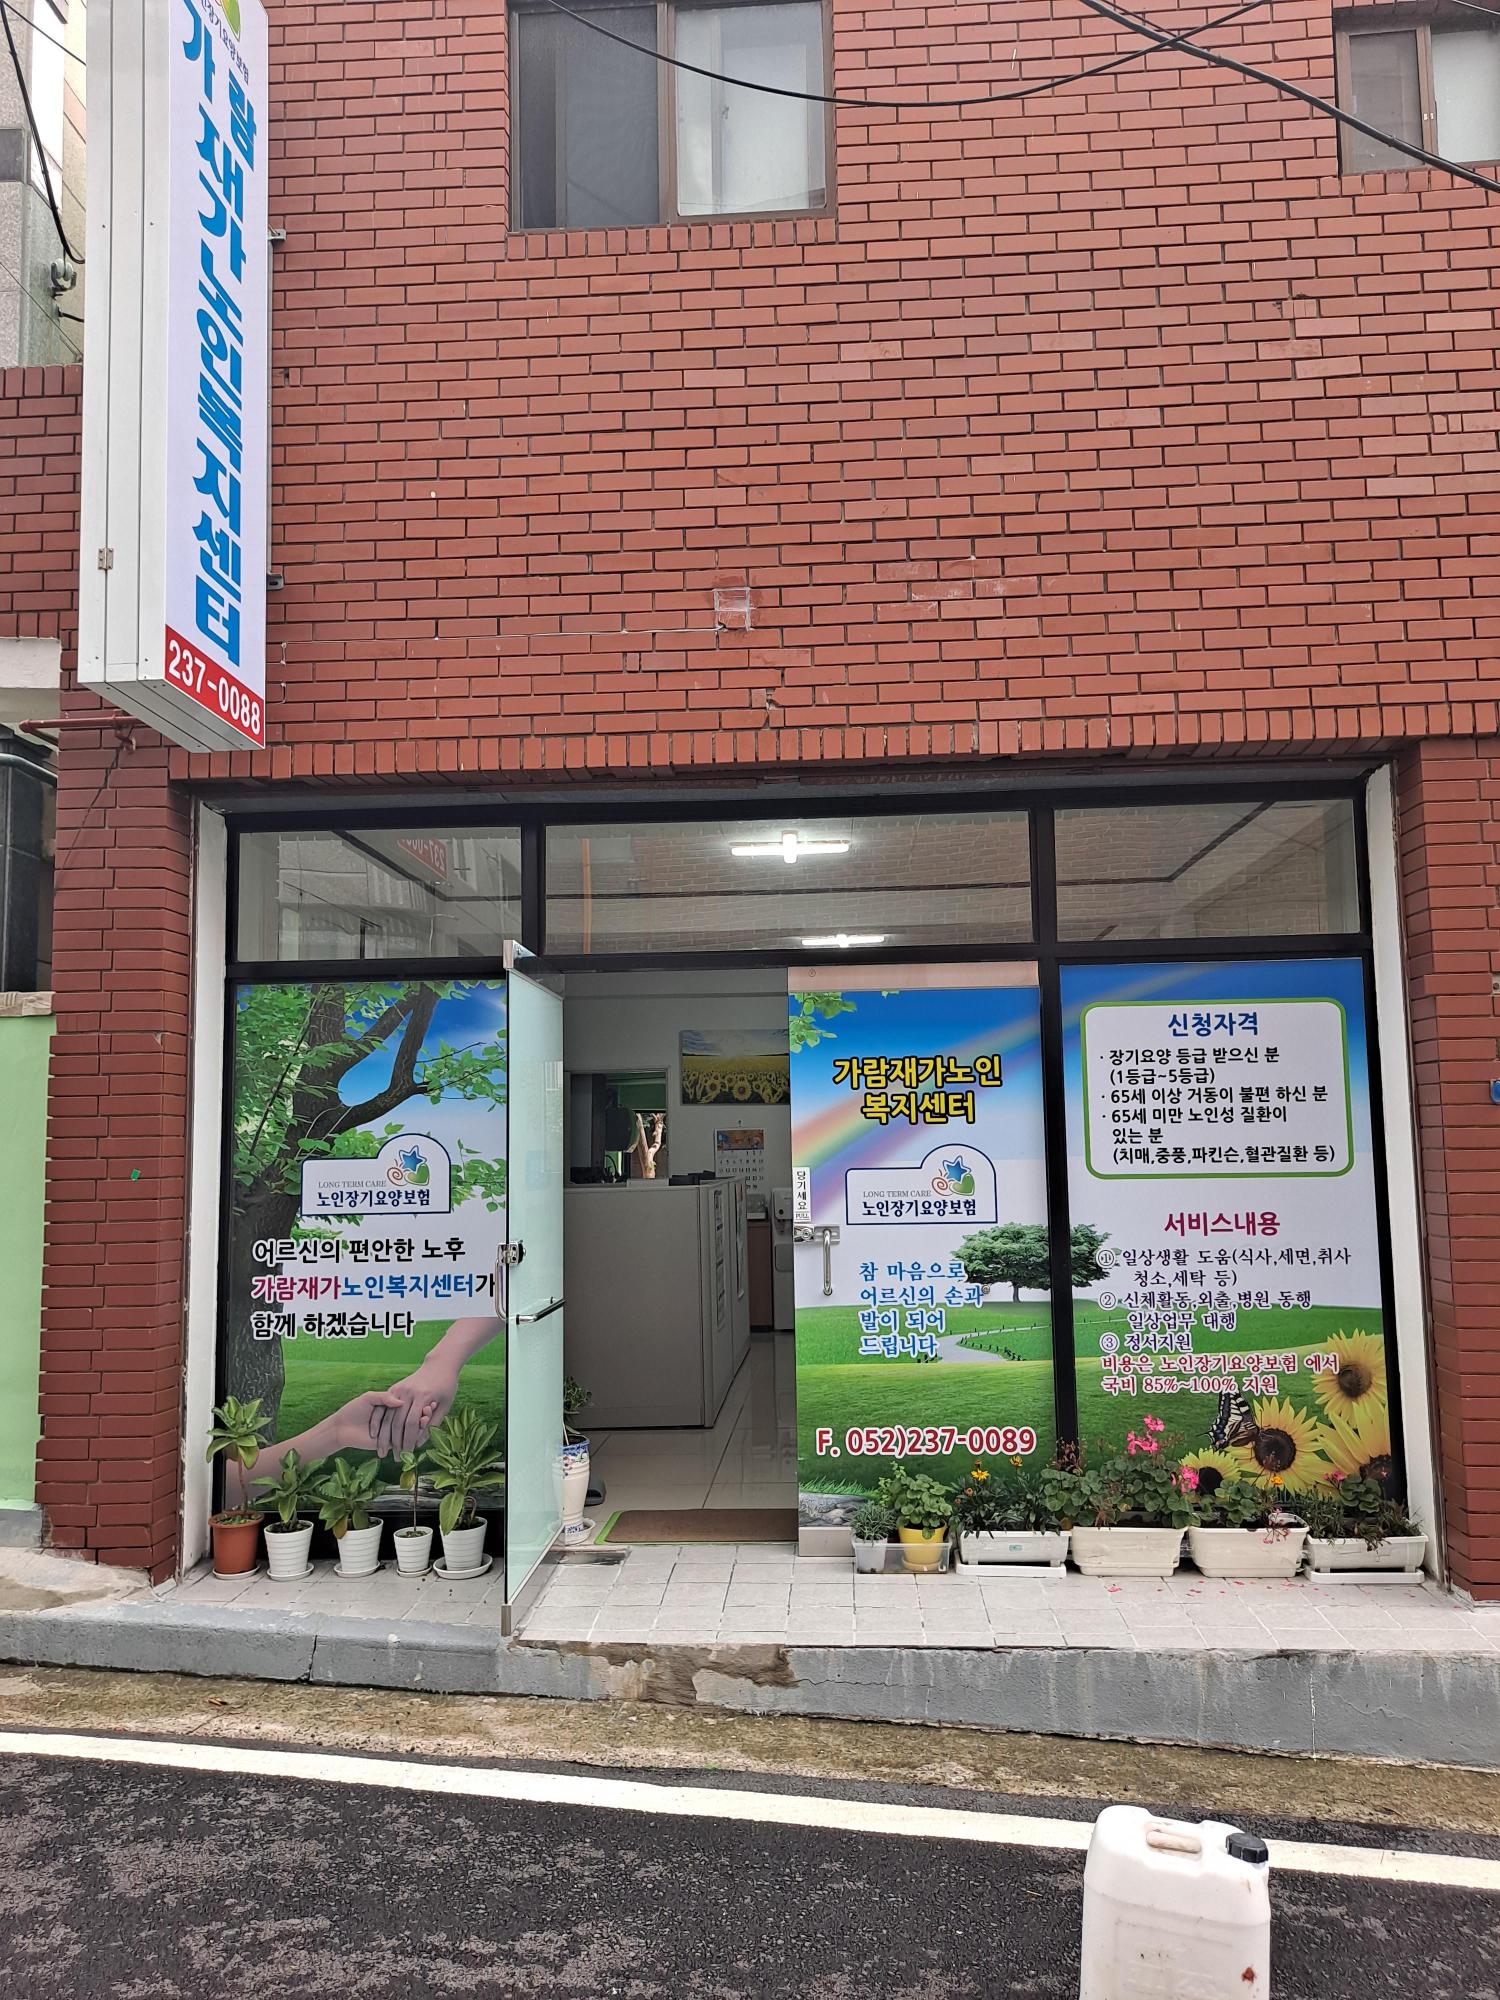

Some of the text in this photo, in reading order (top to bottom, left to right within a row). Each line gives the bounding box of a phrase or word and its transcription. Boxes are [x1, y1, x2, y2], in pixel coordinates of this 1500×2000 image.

[169, 639, 260, 735] 237-0088
[1168, 1012, 1259, 1038] 신청자격
[1109, 1046, 1280, 1066] 장기요양 등급 받으신 분
[833, 1054, 1002, 1089] 가람재가노인
[1110, 1067, 1215, 1086] (1등급~5등급)
[1110, 1086, 1328, 1105] 65세 이상 거동이 불편 하신 분
[861, 1090, 975, 1124] 복지센터
[1111, 1105, 1287, 1124] 65세 미만 노인성 질환이
[1112, 1128, 1163, 1144] 있는 분
[1113, 1145, 1335, 1165] (치매,중풍,파킨슨,혈관질환 등)
[318, 1181, 340, 1189] LONG
[365, 1180, 386, 1188] CARE
[796, 1170, 807, 1210] 당기세요
[886, 1190, 909, 1198] TERM
[317, 1188, 430, 1208] 노인장기요양보험
[862, 1199, 976, 1217] 노인장기요양보험
[1164, 1211, 1280, 1237] 서비스내용
[254, 1237, 466, 1264] 어르신의 편안한 노후
[1122, 1249, 1189, 1267] 일상생활
[860, 1261, 966, 1282] 참 마음으로
[1134, 1269, 1237, 1288] 청소,세탁 등)
[252, 1273, 495, 1301] 가람재가노인복지센터가
[860, 1285, 984, 1307] 어르신의 손과
[1124, 1291, 1271, 1310] 신체활동,외출,병원
[1278, 1290, 1312, 1308] 동행
[252, 1311, 415, 1338] 함께 하겠습니다
[860, 1310, 944, 1331] 발이 되어
[1129, 1312, 1236, 1330] 일상업무 대행
[860, 1335, 937, 1356] 드립니다
[1125, 1333, 1192, 1351] 정서지원
[1102, 1353, 1340, 1374] 비용은 노인장기요양보험 에서
[1103, 1376, 1278, 1395] 국비 85%~100% 지원
[818, 1427, 1036, 1457] F. 052)237-0089
